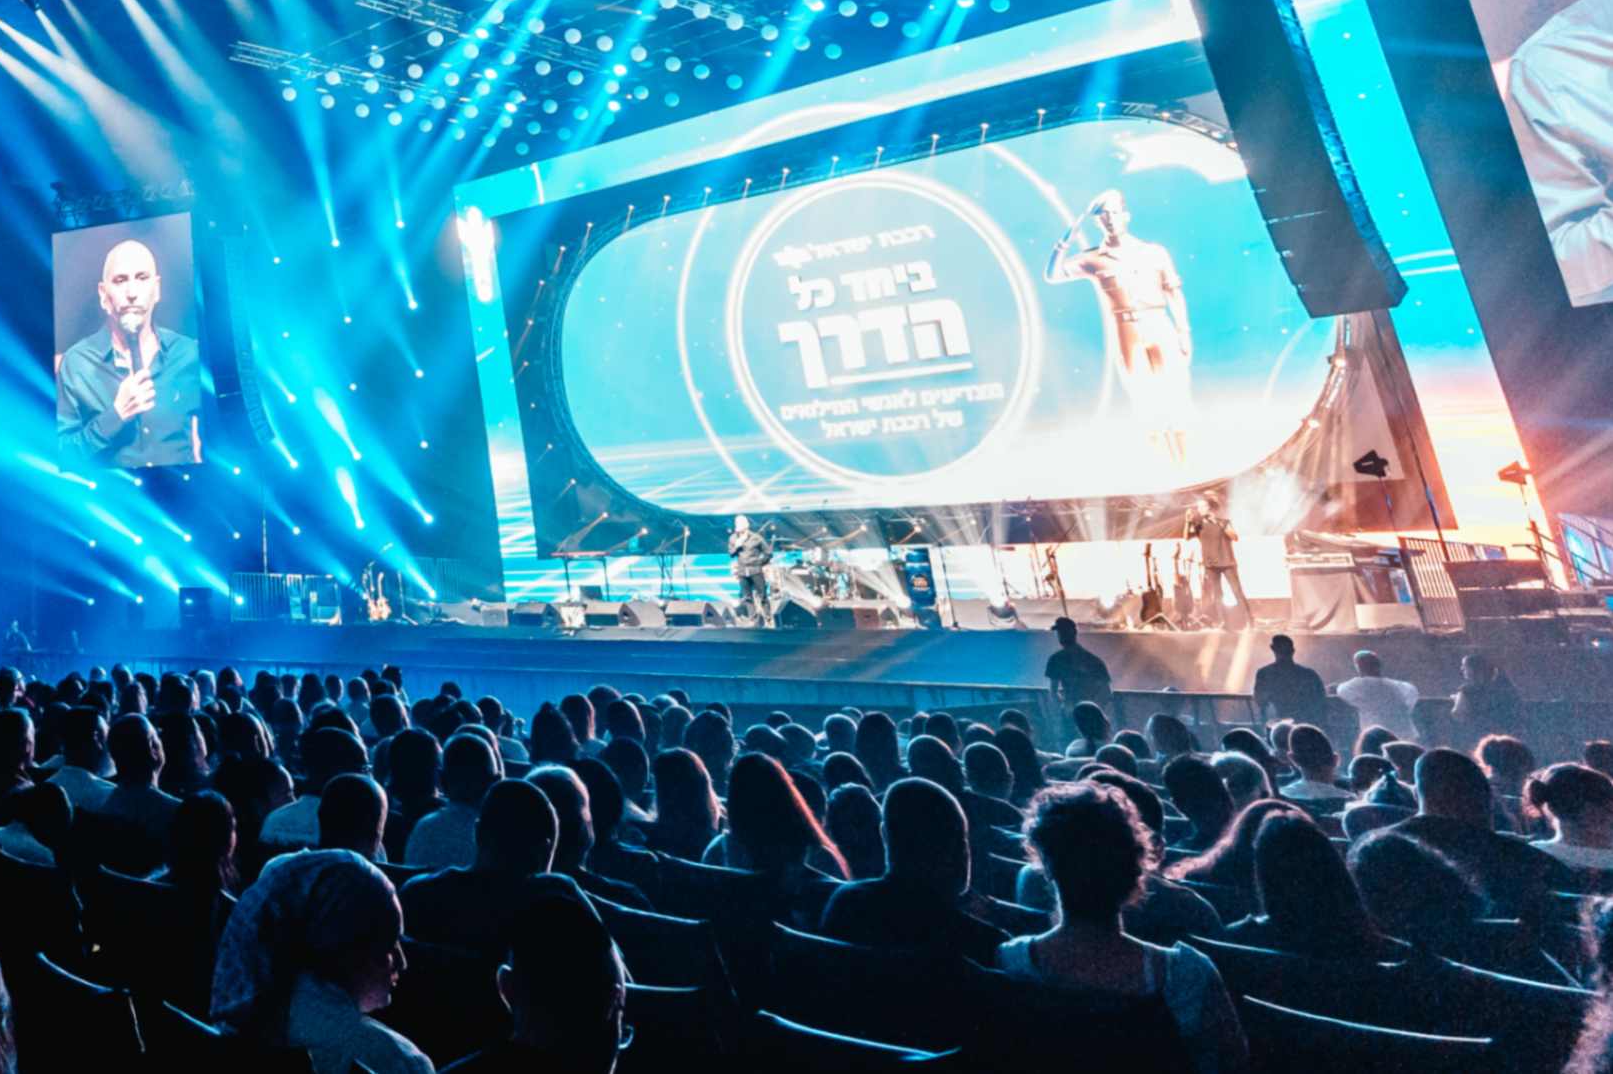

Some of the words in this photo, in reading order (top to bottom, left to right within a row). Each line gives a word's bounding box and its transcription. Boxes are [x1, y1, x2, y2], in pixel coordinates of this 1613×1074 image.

[878, 226, 935, 246] רכבת
[807, 236, 872, 258] ישראל
[840, 261, 937, 301] ביחד
[788, 275, 835, 310] כל
[778, 299, 970, 388] הדרך
[820, 419, 876, 438] ישראל
[882, 414, 930, 433] רכבת
[932, 409, 963, 427] של
